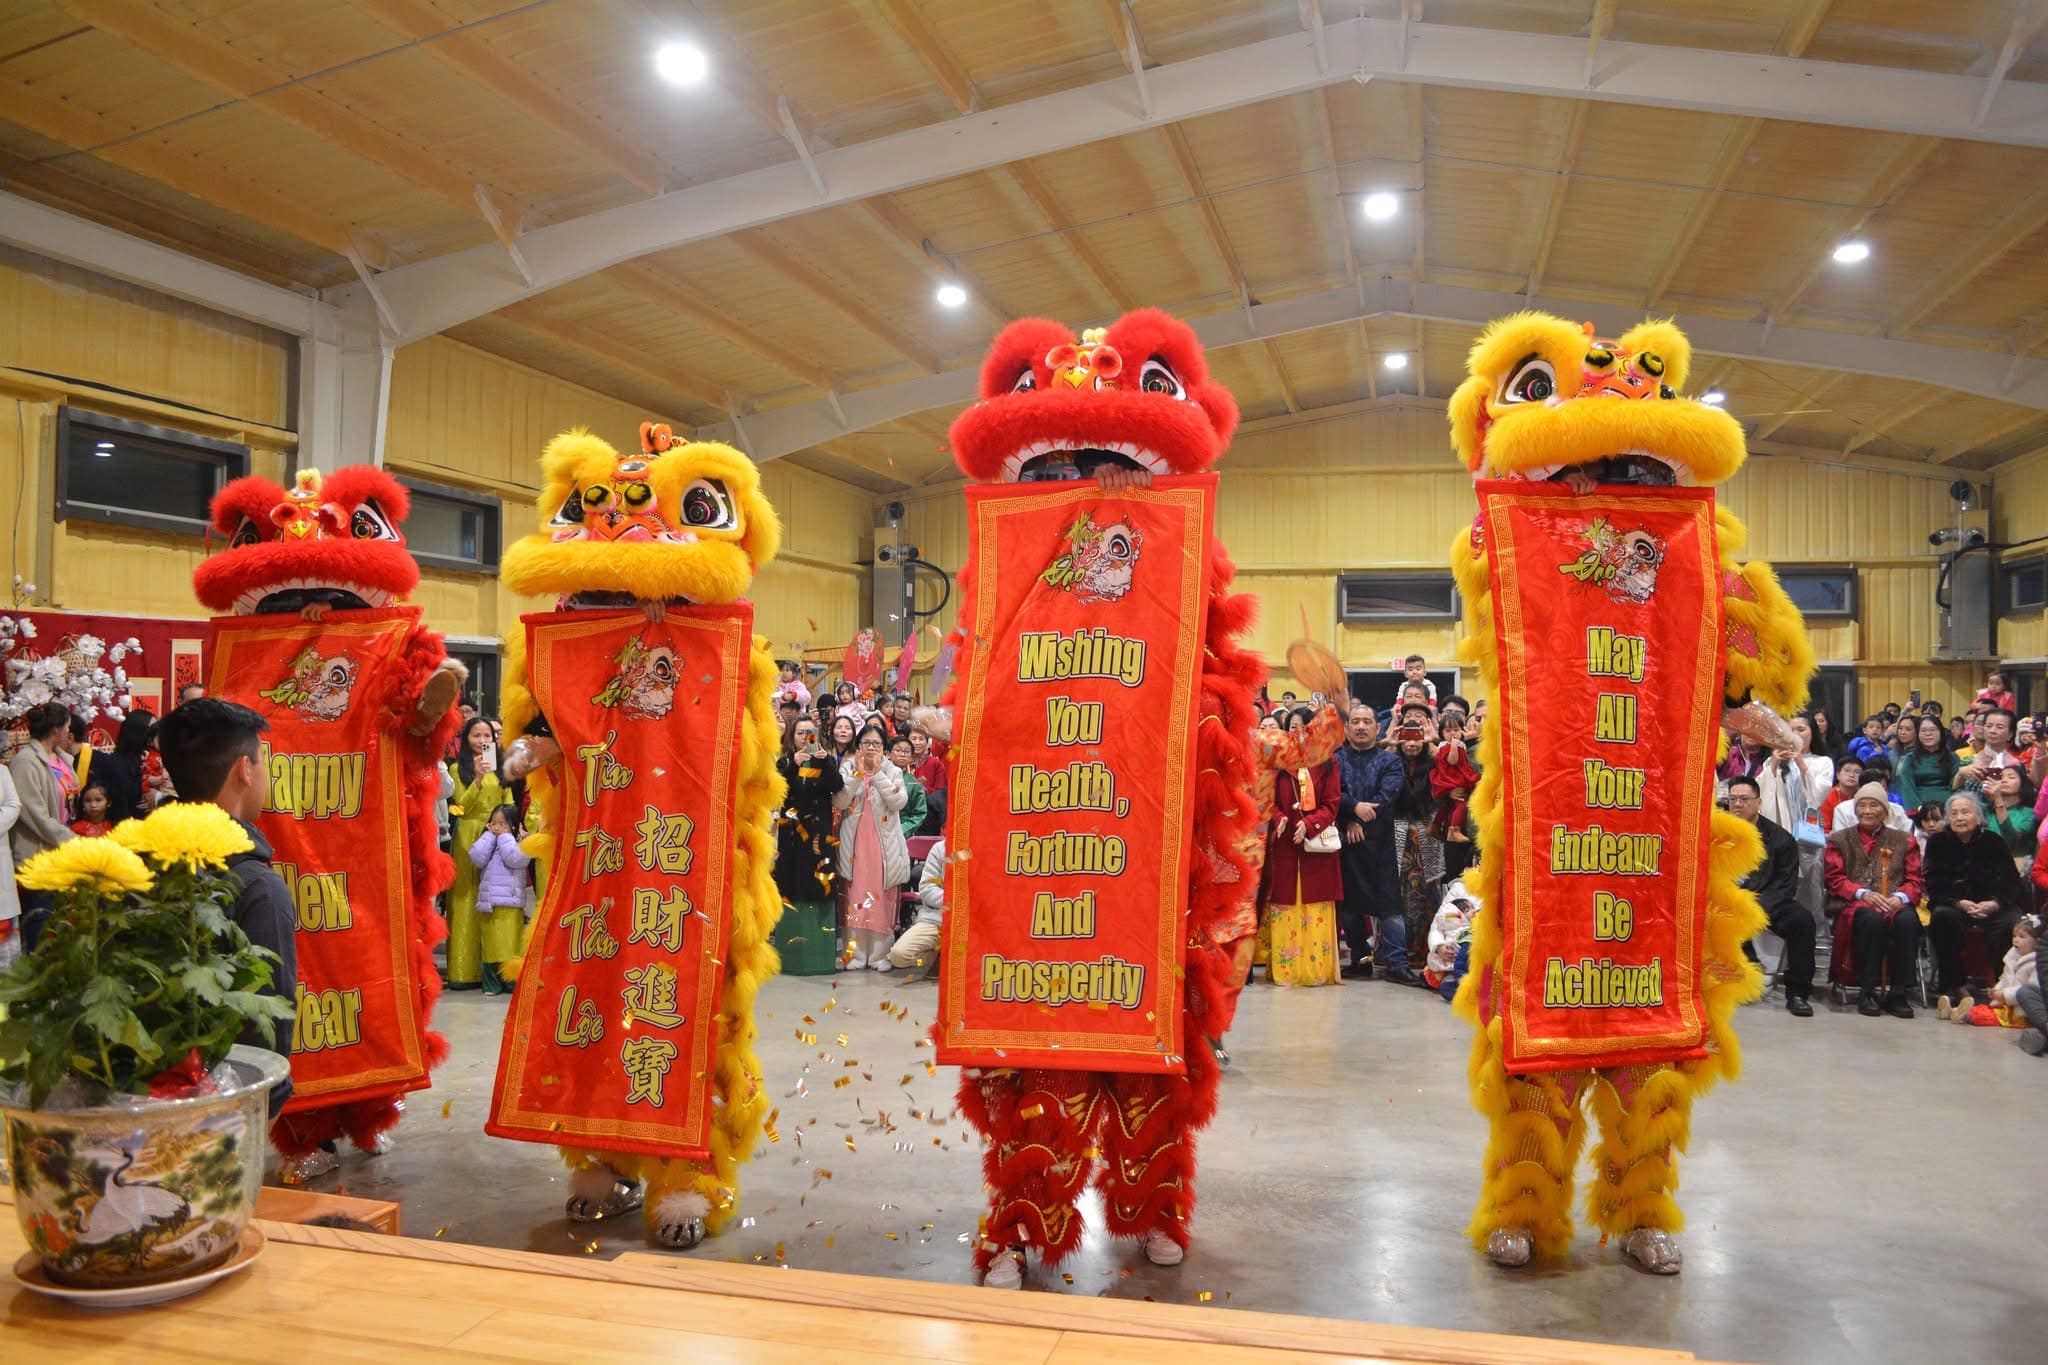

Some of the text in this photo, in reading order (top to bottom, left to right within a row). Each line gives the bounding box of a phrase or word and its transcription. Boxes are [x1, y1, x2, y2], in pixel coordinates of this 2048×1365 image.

[1018, 627, 1147, 687] Wishing
[1587, 626, 1646, 683] May
[1046, 695, 1104, 747] You
[1595, 692, 1637, 744] All
[1583, 758, 1646, 810] Your
[576, 823, 624, 884] Tài
[1005, 829, 1127, 877] Fortune
[1551, 823, 1663, 876] Endeavor
[560, 904, 619, 963] Tấn
[1031, 890, 1095, 939] And
[1593, 891, 1634, 942] Be
[981, 953, 1146, 1009] Prosperity
[1543, 956, 1664, 1009] Achieved
[556, 985, 604, 1048] Lộc
